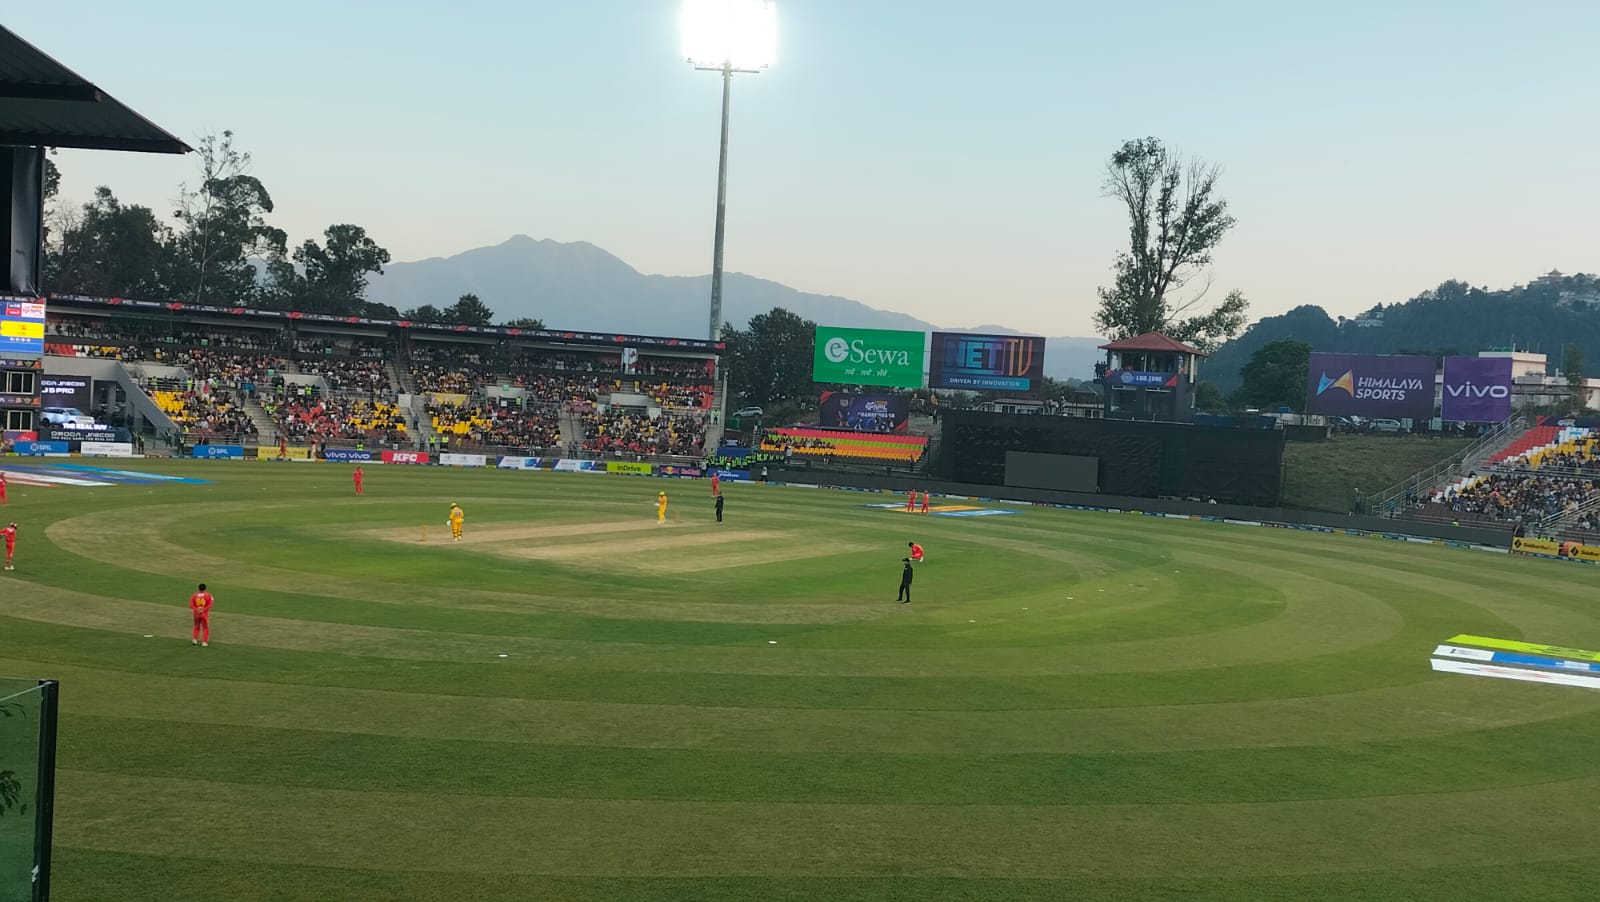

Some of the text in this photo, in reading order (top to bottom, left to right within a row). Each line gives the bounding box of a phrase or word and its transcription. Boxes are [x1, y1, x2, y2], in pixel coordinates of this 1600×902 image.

[825, 338, 910, 365] eSewa
[1358, 377, 1423, 390] HIMALAYA
[1446, 381, 1508, 398] vivo
[1355, 388, 1406, 400] SPORTS
[325, 451, 370, 460] vivo vivo
[392, 453, 418, 462] KFC
[617, 464, 642, 472] inDrive
